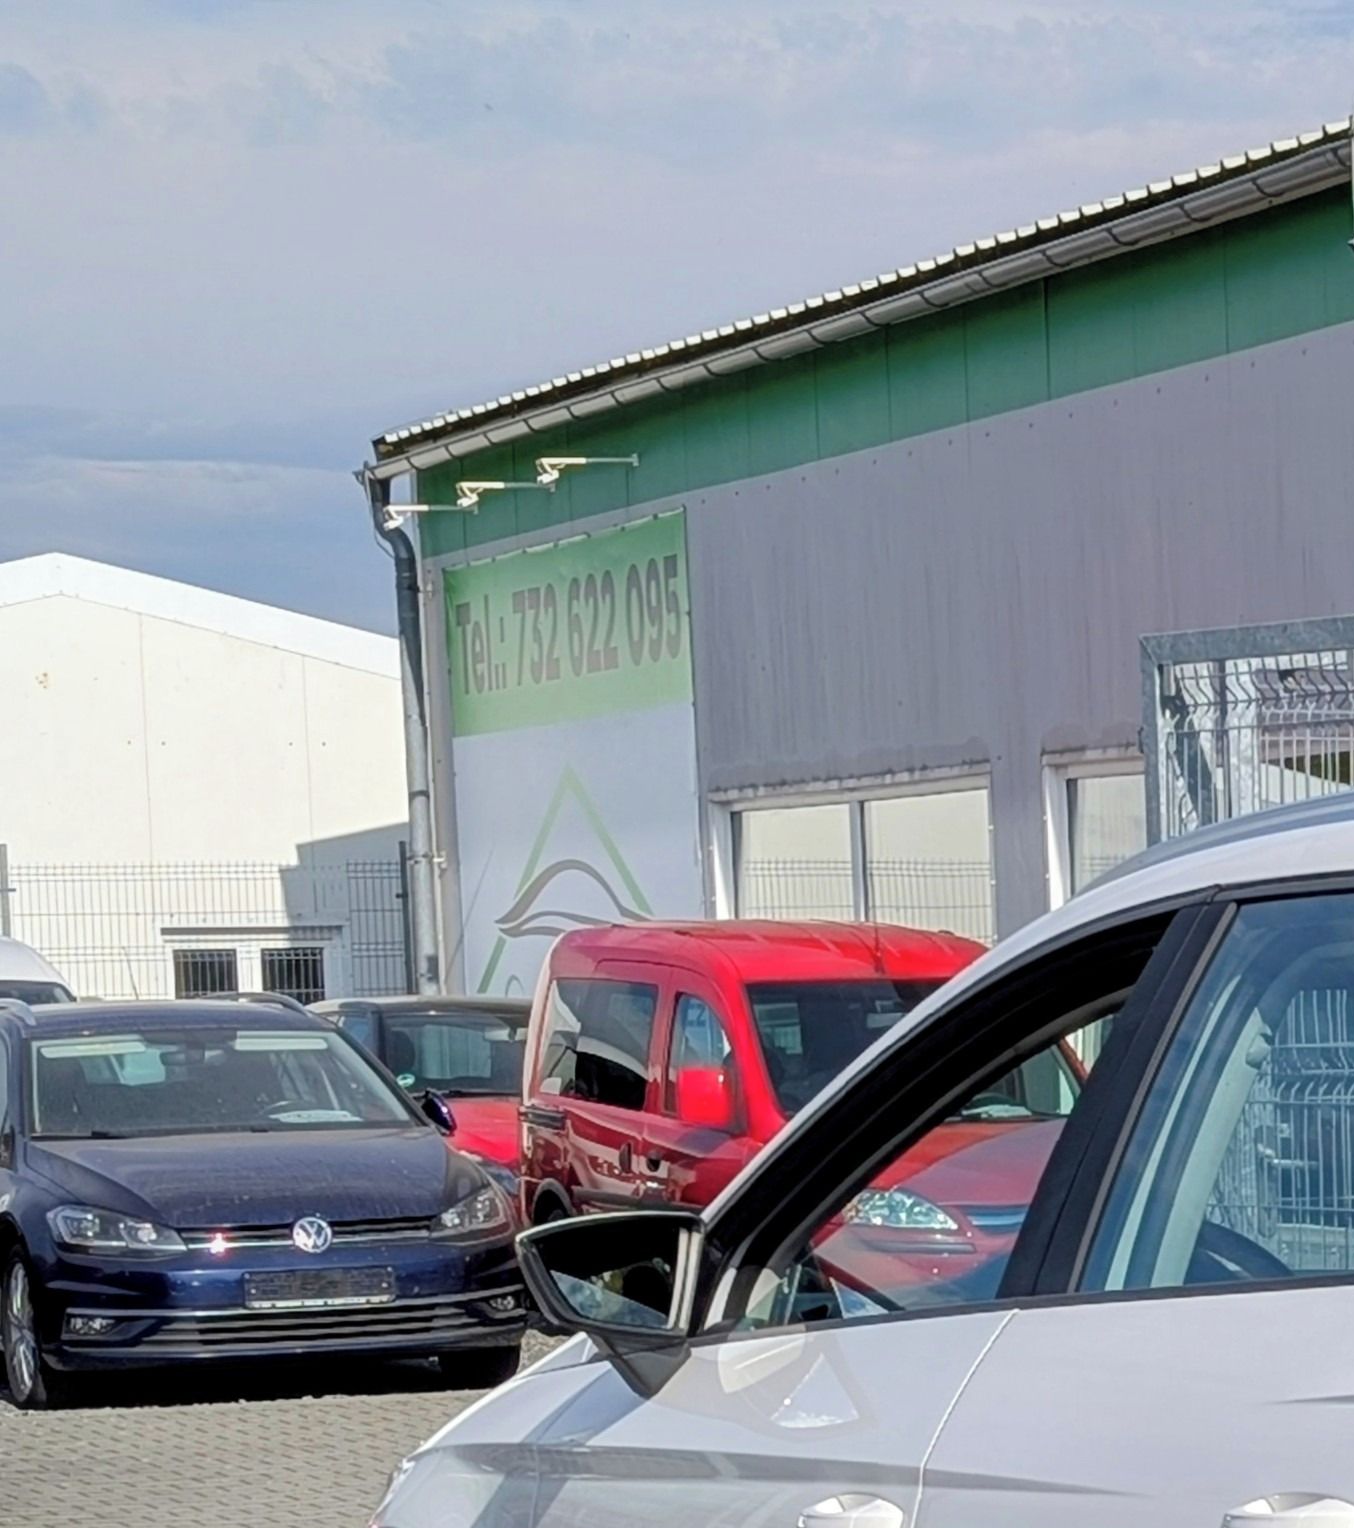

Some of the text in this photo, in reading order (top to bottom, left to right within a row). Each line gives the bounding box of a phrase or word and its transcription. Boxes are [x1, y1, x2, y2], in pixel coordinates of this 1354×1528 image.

[456, 553, 682, 696] Tel.: 732 622 095
